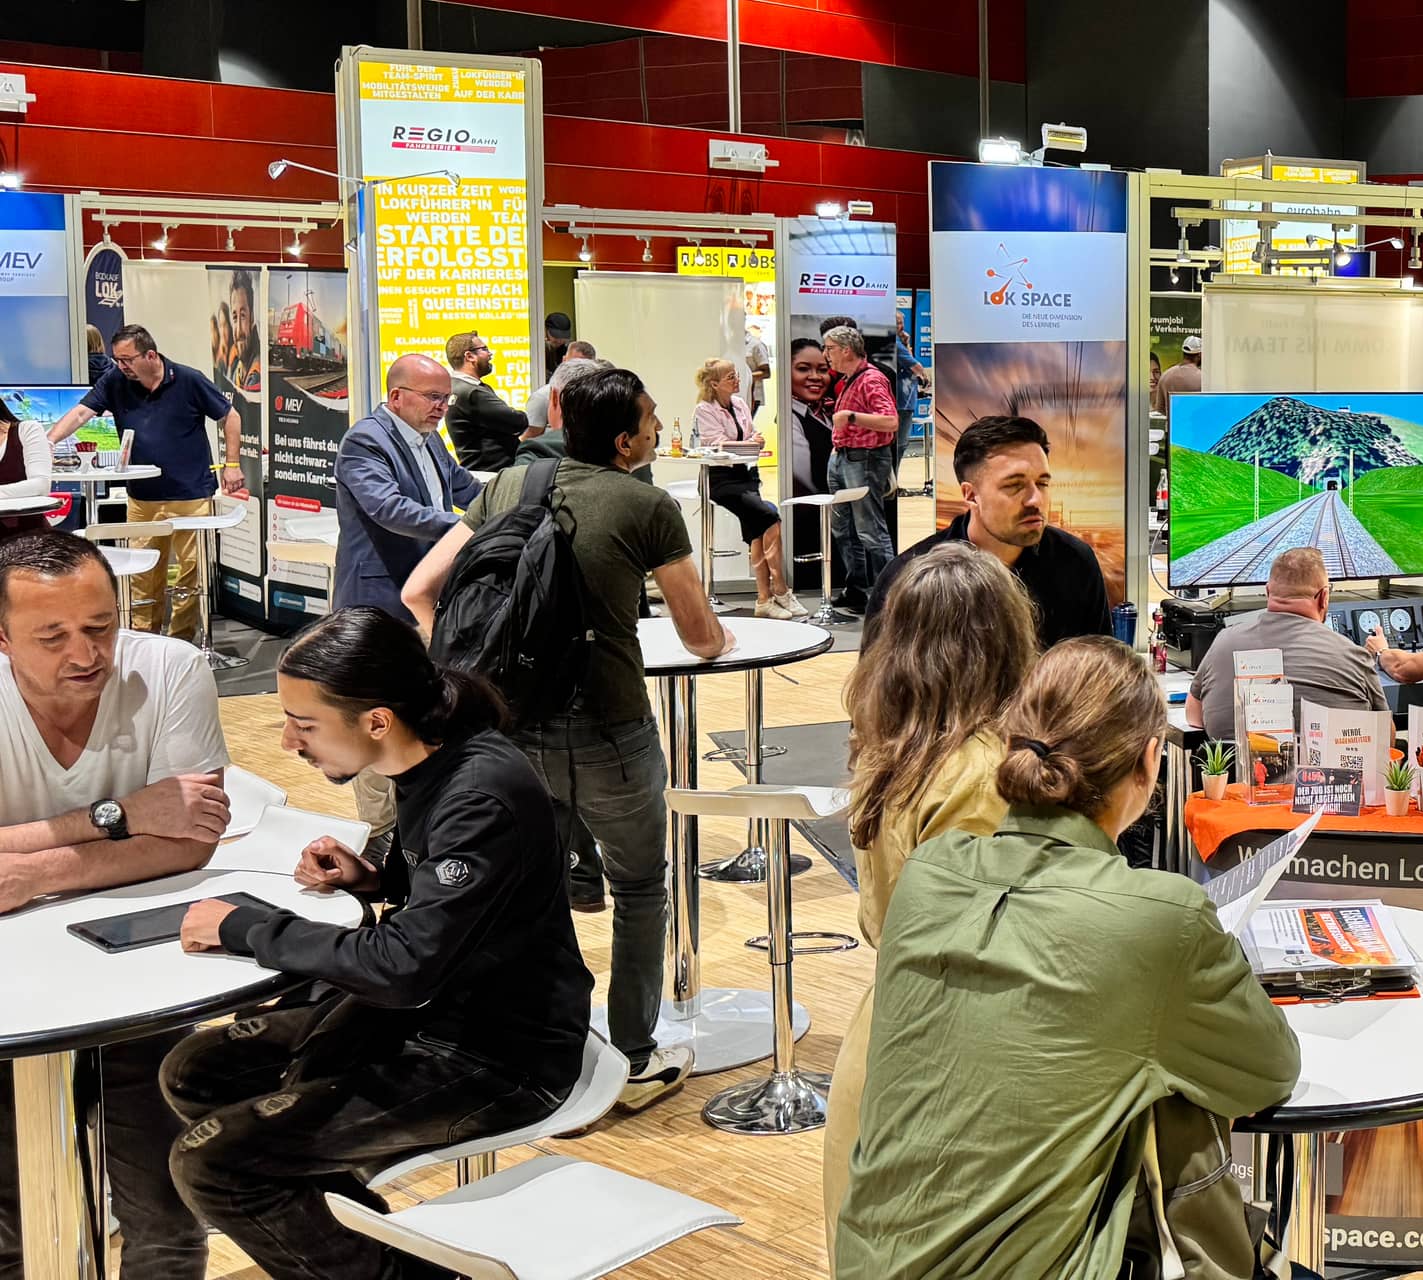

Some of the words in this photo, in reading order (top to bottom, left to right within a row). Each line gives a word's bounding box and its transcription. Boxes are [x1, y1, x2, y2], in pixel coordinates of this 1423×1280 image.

[392, 126, 470, 142] REGIO
[377, 184, 392, 195] IN
[398, 184, 458, 196] KURZER
[463, 185, 493, 196] ZEIT
[406, 212, 470, 223] WERDEN
[379, 225, 481, 245] STARTE
[377, 247, 524, 267] ERFOLGSST
[406, 269, 436, 280] DER
[800, 273, 865, 288] REGIO
[95, 281, 118, 297] LOK
[456, 284, 522, 295] EINFACH
[984, 291, 1015, 306] LOK
[1021, 292, 1072, 307] SPACE
[285, 398, 303, 412] MEV
[275, 434, 286, 446] Bei
[288, 438, 301, 448] uns
[303, 437, 326, 451] fährst
[275, 451, 293, 464] nicht
[295, 453, 327, 468] schwarz
[275, 469, 305, 483] sondern
[1298, 787, 1309, 796] DER
[1324, 785, 1333, 794] IST
[1335, 784, 1352, 793] NOCH
[1295, 796, 1313, 805] NICHT
[1315, 793, 1355, 804] ABGEFAHREN
[1285, 855, 1390, 881] machen
